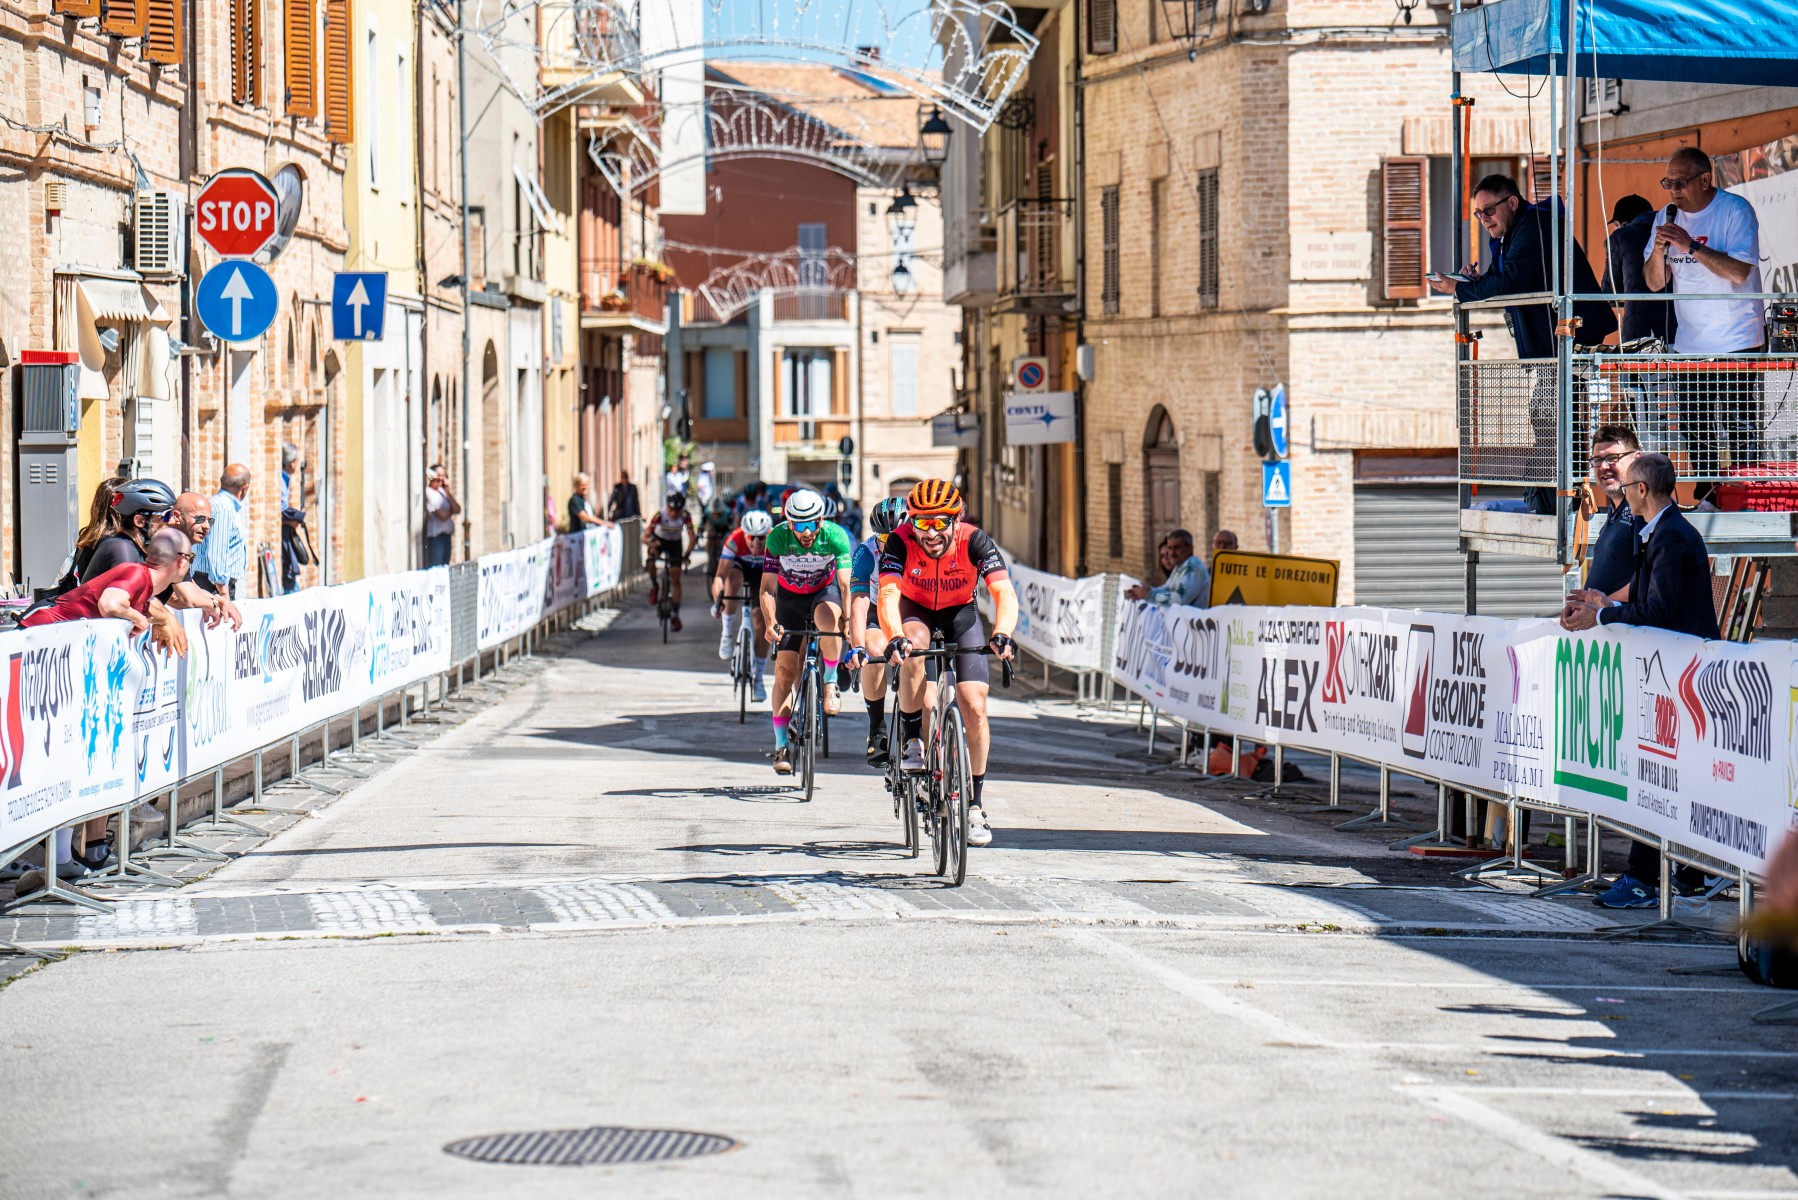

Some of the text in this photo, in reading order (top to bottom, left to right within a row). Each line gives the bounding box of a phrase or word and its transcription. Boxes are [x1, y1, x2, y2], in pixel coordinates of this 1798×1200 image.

[201, 201, 271, 231] STOP
[1007, 405, 1045, 416] CONTI
[940, 577, 969, 592] MODA
[1220, 562, 1331, 584] TUTTE LE DIREZIONI
[1258, 619, 1320, 646] CALZATURIFICIO
[1343, 630, 1398, 703] OVERKART
[1452, 631, 1486, 678] ISTAL
[1255, 657, 1320, 733] ALEX
[1432, 678, 1487, 729] GRONDE
[1323, 710, 1397, 743] Printing and Packaging Solutions
[1429, 728, 1483, 769] COSTRUZIONI
[1493, 760, 1543, 788] PELLAMI
[1637, 757, 1679, 793] IMPRESA EDILE
[1689, 801, 1733, 846] PAVIMENTAZIONI
[1733, 814, 1768, 860] INDUSTRIALI
